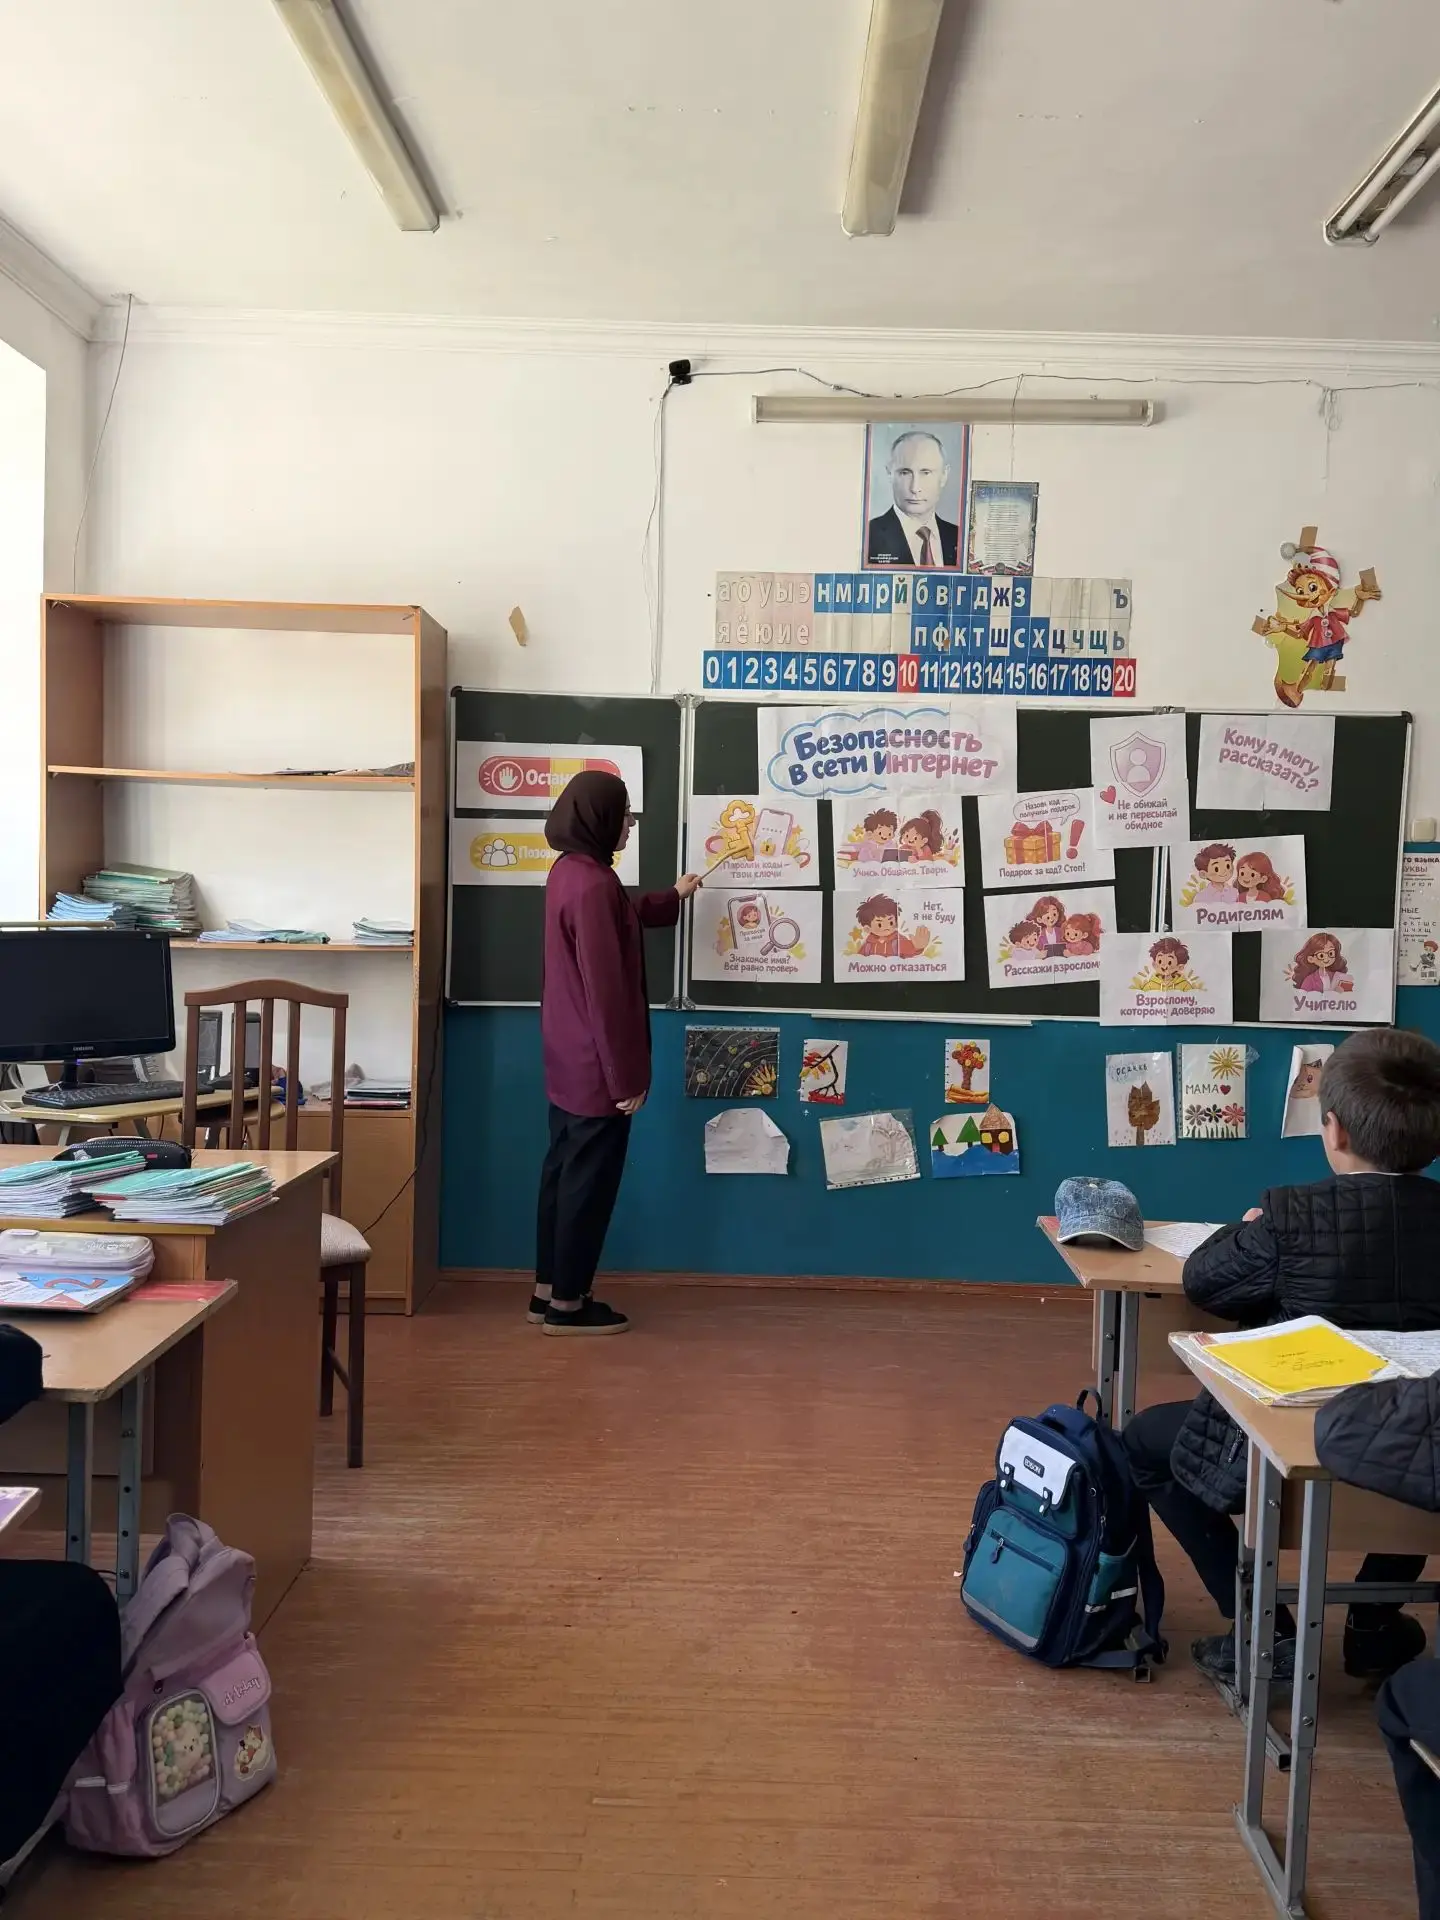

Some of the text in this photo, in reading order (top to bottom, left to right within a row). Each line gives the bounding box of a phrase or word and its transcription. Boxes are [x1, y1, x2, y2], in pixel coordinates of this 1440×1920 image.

[818, 582, 830, 602] н
[836, 584, 852, 603] м
[856, 584, 869, 603] л
[876, 583, 889, 609] р
[916, 577, 928, 605] б
[936, 586, 948, 605] в
[956, 586, 966, 606] г
[974, 587, 988, 610] д
[993, 588, 1010, 606] ж
[914, 627, 926, 646] п
[955, 628, 966, 646] к
[973, 628, 984, 646] т
[992, 628, 1008, 648] ш
[1014, 628, 1025, 648] с
[1032, 629, 1045, 648] х
[706, 656, 1134, 692] 0 1 2 3 4 5 6 7 8 9 10 11 12 13 14 15 16 17 18 19 20
[794, 728, 983, 760] Безопасность
[1224, 728, 1320, 776] Кому я могу
[789, 750, 998, 786] в сети Интернет
[1219, 748, 1319, 792] рассказать?
[1118, 800, 1168, 810] Не обижай
[1130, 808, 1178, 821] пересылай
[1125, 821, 1162, 830] обидное
[754, 870, 782, 878] ключи
[999, 868, 1032, 879] Подарок
[1064, 862, 1086, 872] Стоп!
[924, 902, 944, 912] Нет,
[935, 912, 956, 924] буду
[1196, 908, 1284, 924] Родителям
[771, 956, 790, 964] имя?
[724, 962, 799, 974] Всё равно проверь
[848, 962, 946, 973] Можно отказаться
[1004, 960, 1100, 976] Расскажи взрослом
[1136, 994, 1198, 1006] Взрослому,
[1294, 996, 1357, 1012] Учителю
[1120, 1006, 1215, 1018] которому доверяю
